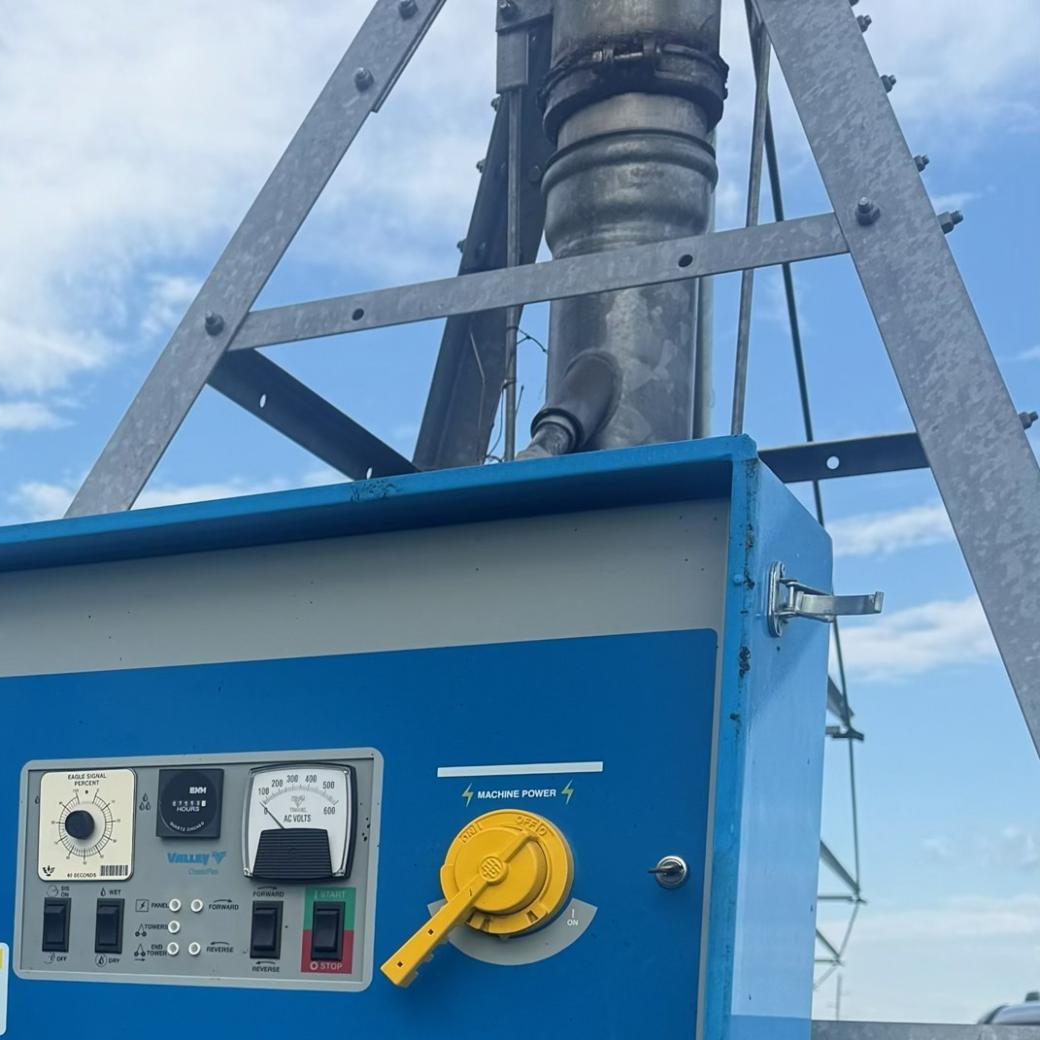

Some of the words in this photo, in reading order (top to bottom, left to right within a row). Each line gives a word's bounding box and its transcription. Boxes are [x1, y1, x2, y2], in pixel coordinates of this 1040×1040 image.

[272, 779, 283, 787] 200
[286, 775, 298, 783] 300
[477, 789, 519, 799] MACHINE
[522, 789, 556, 798] POWER
[320, 962, 343, 970] STOP
